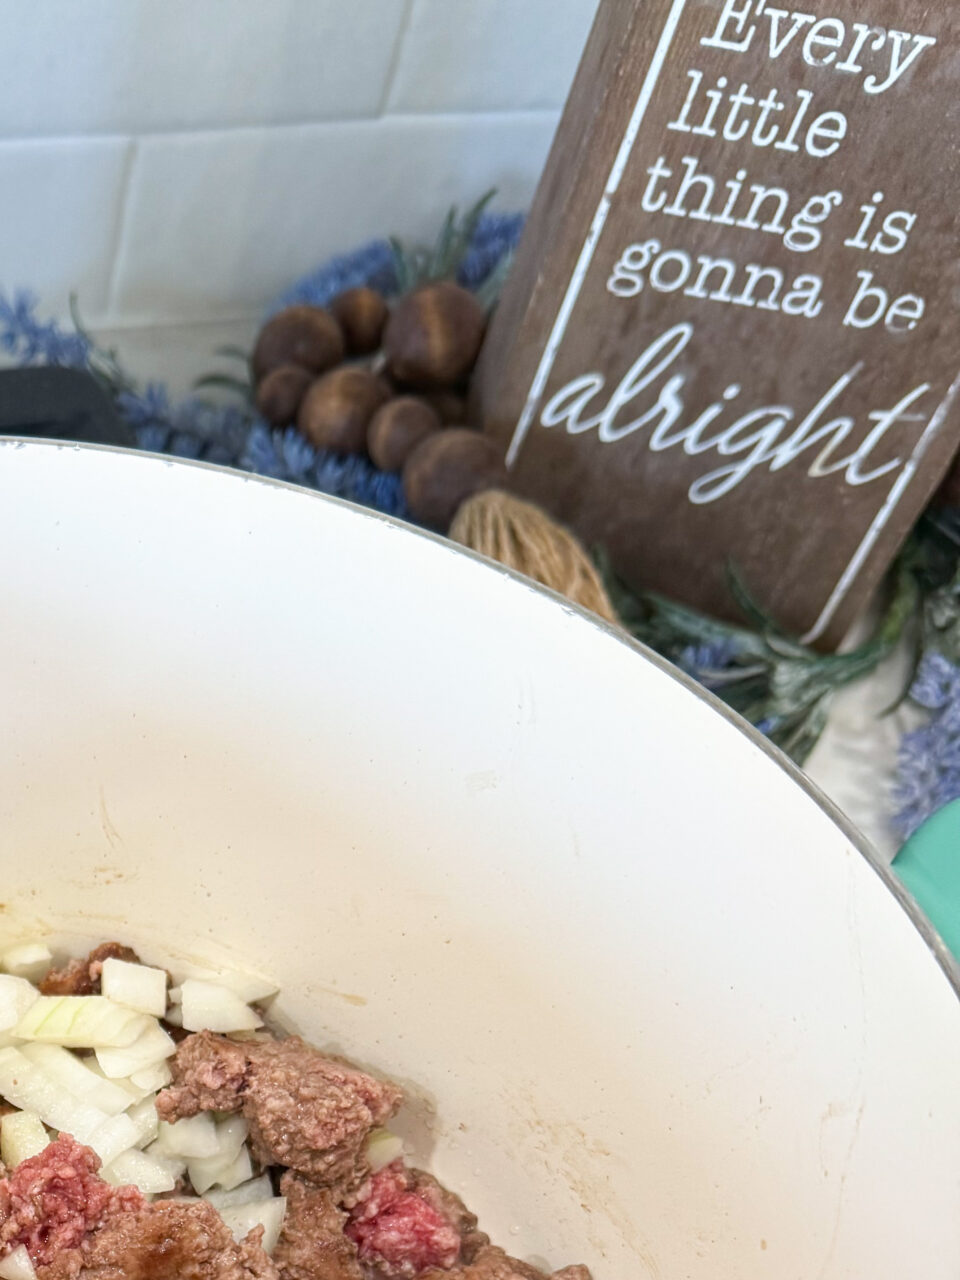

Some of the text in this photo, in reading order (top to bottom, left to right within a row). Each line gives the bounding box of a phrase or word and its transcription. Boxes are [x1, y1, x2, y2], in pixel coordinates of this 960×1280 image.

[700, 0, 936, 94] Every
[667, 69, 847, 157] little
[640, 156, 917, 255] thing is
[606, 238, 925, 331] gonna be
[540, 322, 931, 504] alright
